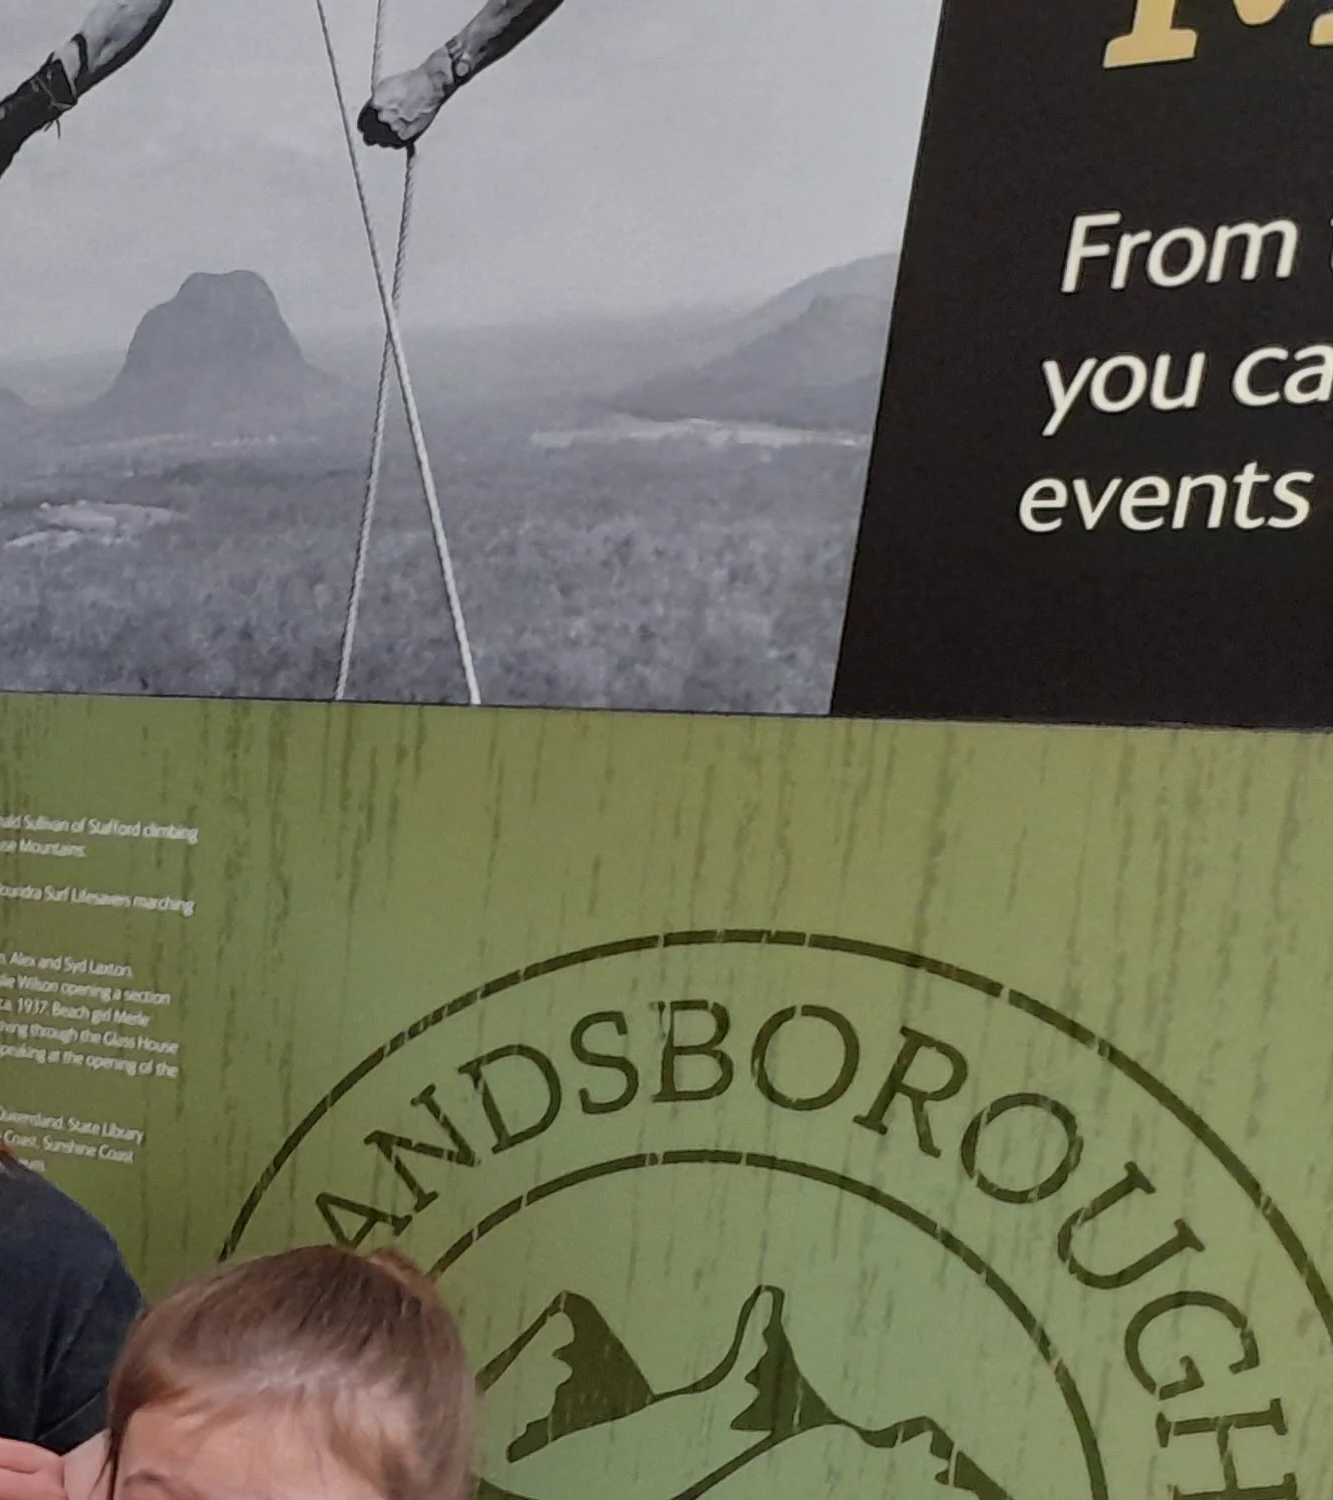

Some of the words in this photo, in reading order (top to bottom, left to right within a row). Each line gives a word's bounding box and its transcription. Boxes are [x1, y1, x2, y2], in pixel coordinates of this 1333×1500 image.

[1061, 211, 1298, 293] From
[1041, 351, 1206, 437] you
[1232, 343, 1333, 408] ca
[1018, 461, 1314, 533] events
[71, 817, 87, 833] of
[37, 956, 62, 970] and
[30, 1024, 78, 1045] through
[80, 1030, 101, 1044] the
[138, 1037, 179, 1055] House
[62, 1050, 83, 1065] the
[86, 1054, 137, 1076] opening
[138, 1060, 154, 1075] of
[155, 1061, 178, 1079] the
